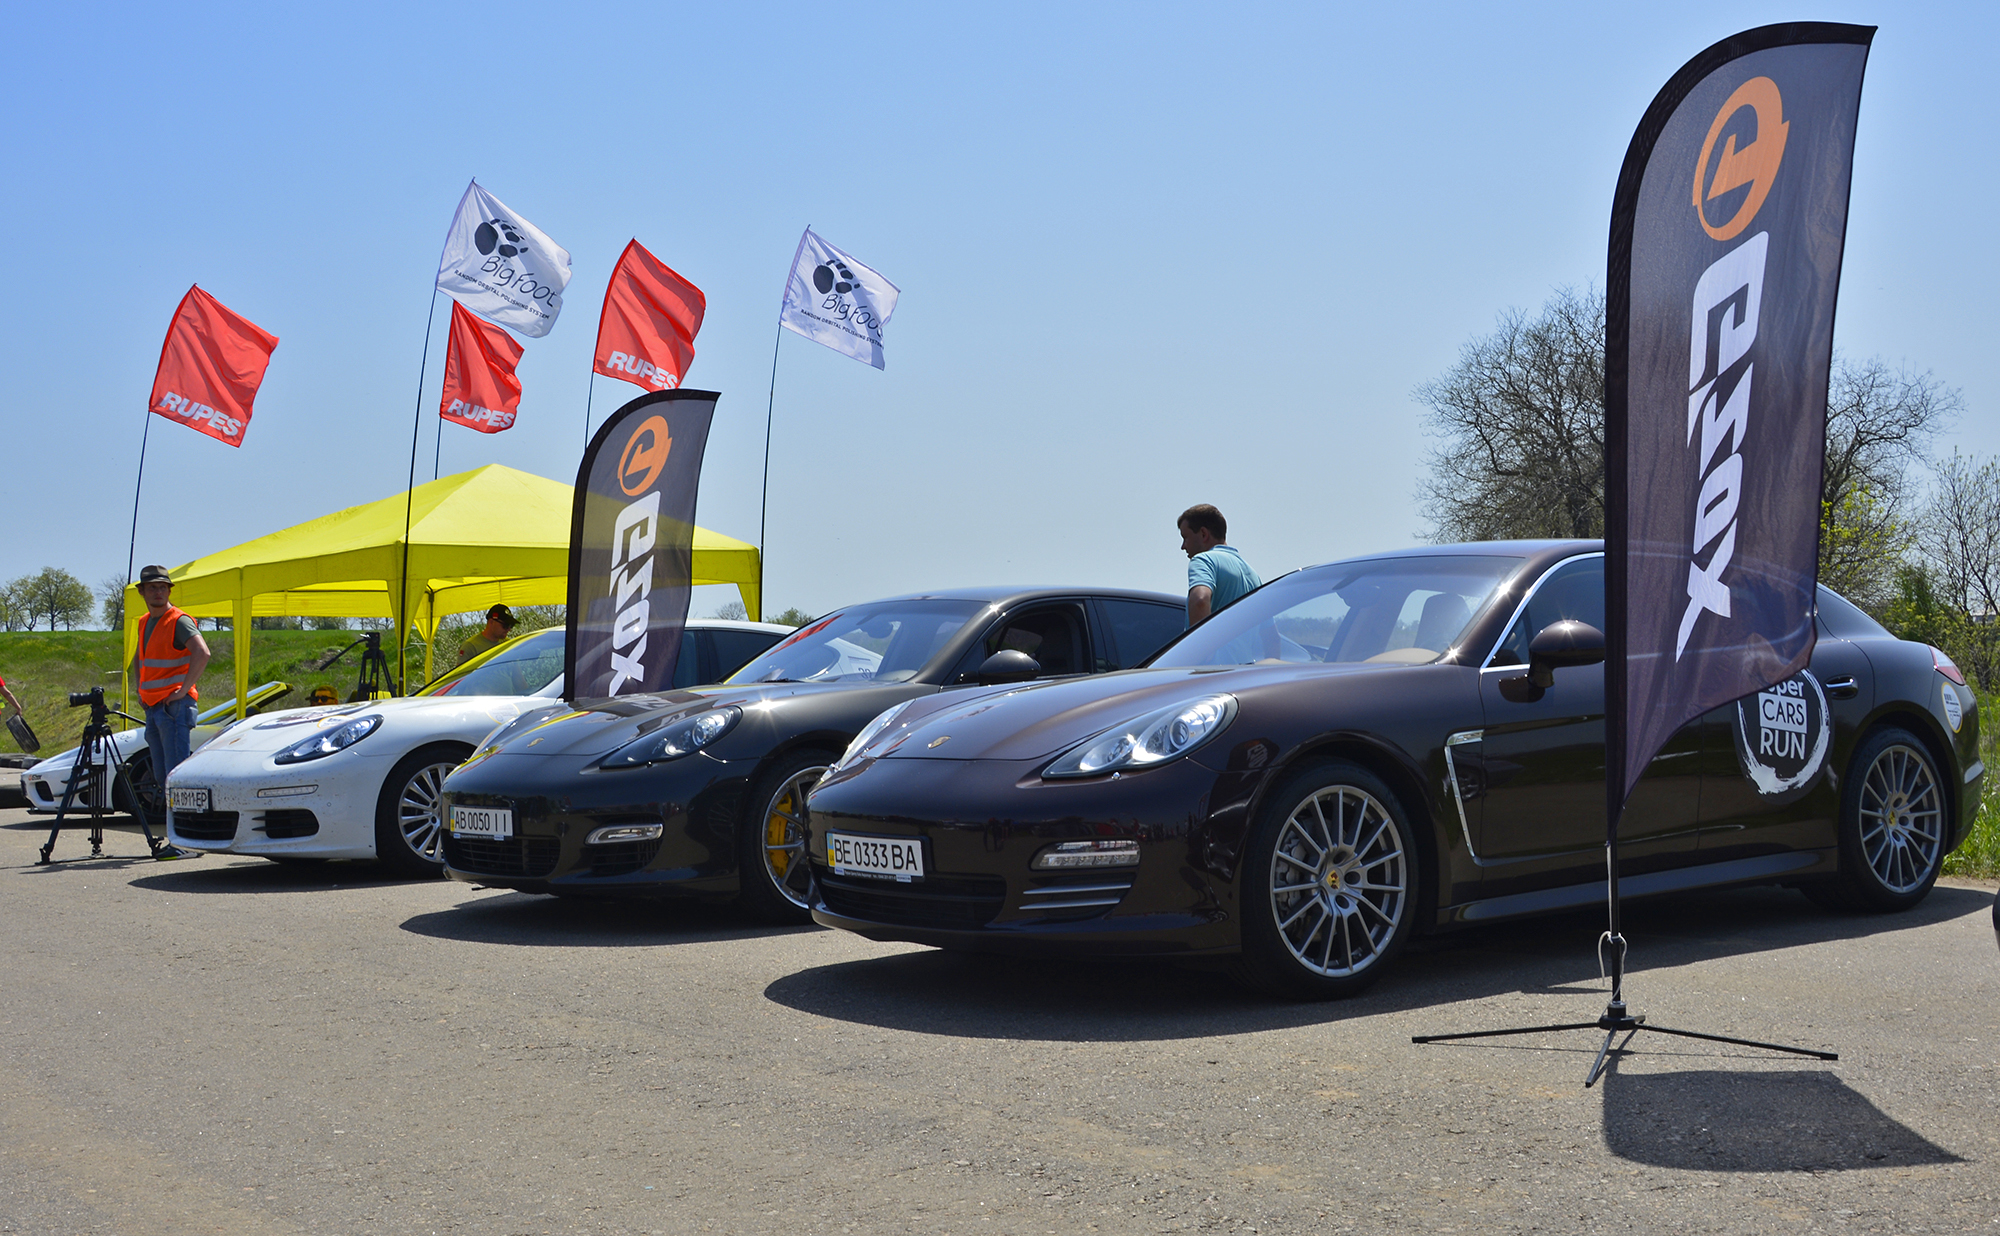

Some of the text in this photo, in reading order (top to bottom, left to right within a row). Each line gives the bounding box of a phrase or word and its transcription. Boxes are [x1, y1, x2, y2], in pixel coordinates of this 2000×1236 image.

[454, 269, 551, 320] RANDOM ORBITAL POLISHING SYSTEM
[606, 350, 678, 390] RUPES
[159, 391, 243, 437] RUPES
[447, 398, 516, 428] RUPES
[1767, 679, 1804, 698] per
[1762, 698, 1805, 726] CARS
[1760, 727, 1806, 760] RUN
[854, 841, 888, 869] 0333
[891, 844, 918, 871] BA
